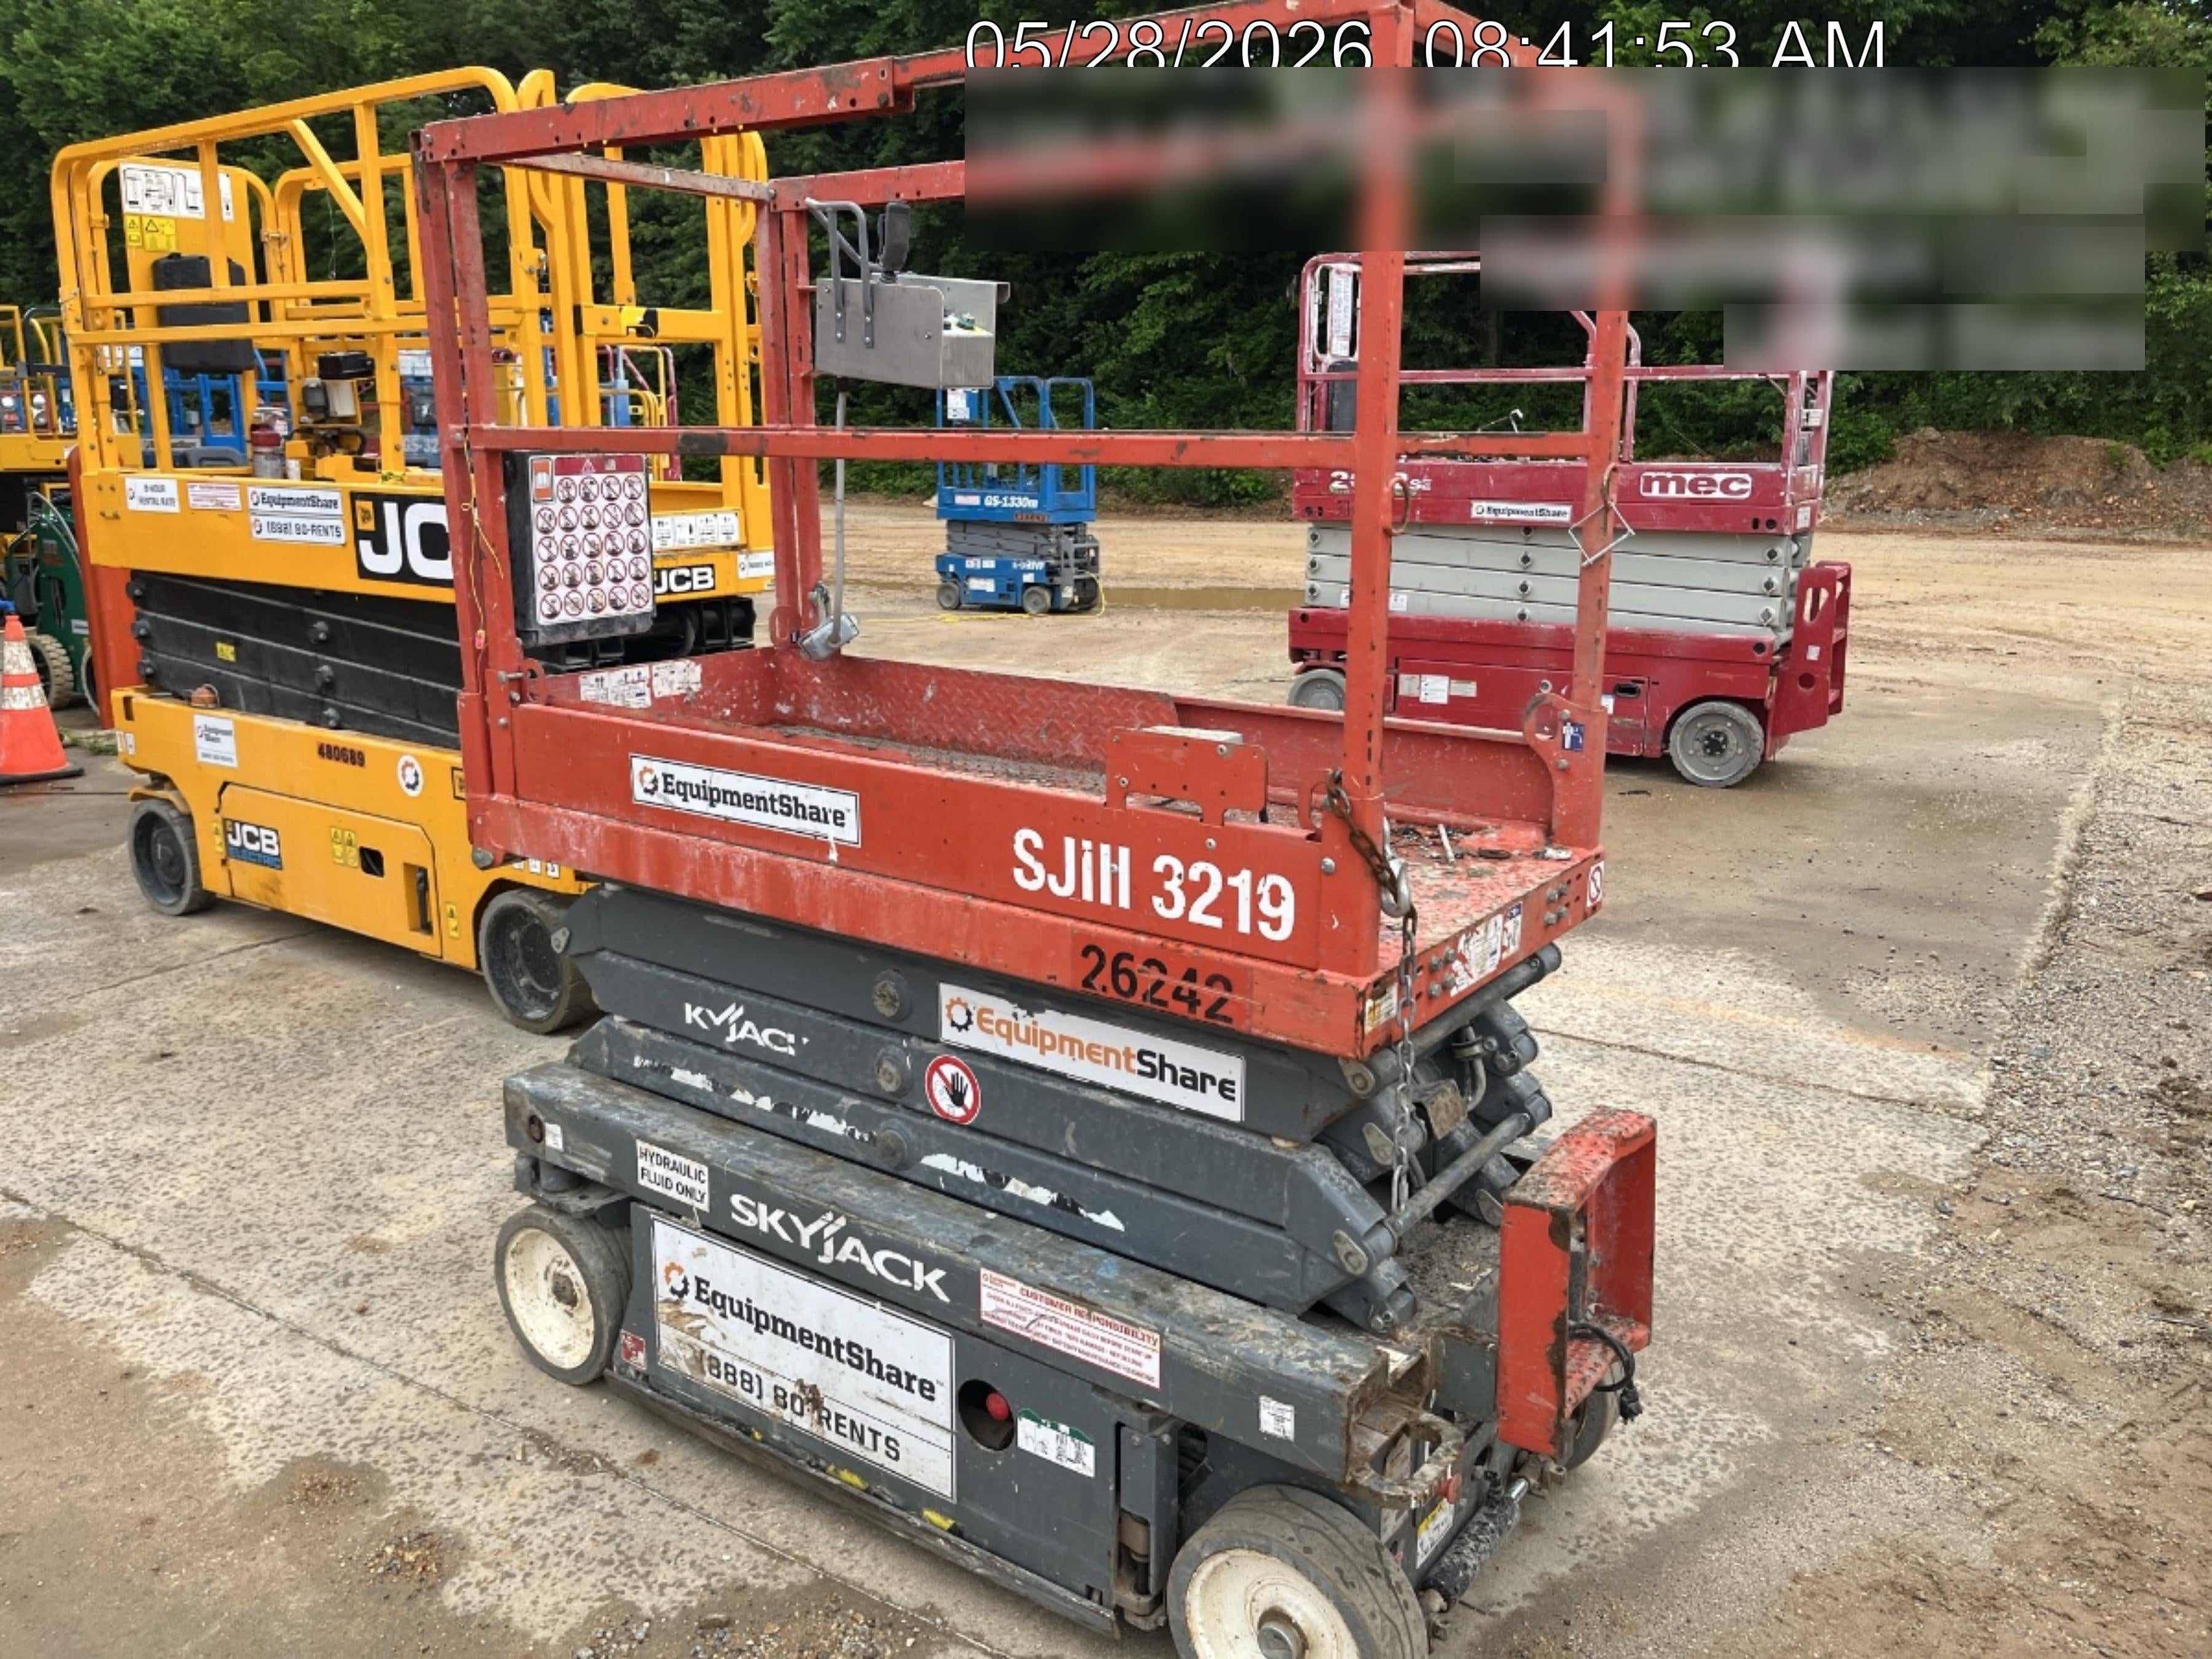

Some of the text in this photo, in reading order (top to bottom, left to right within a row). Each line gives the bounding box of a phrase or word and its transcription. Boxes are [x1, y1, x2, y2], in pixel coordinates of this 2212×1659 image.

[261, 492, 339, 509] EquipmentShare
[1486, 506, 1567, 517] EquipmentShare
[1642, 474, 1751, 496] mec
[654, 566, 715, 595] JCB
[662, 772, 846, 827] EquipmentShare
[227, 822, 280, 857] JCB
[1151, 854, 1295, 942] 3219
[1081, 943, 1234, 1025] 26242
[976, 1006, 1236, 1102] EquipmentShare
[639, 1145, 707, 1184] HYDRAULIC
[641, 1166, 707, 1204] FLUID ONLY
[729, 1193, 950, 1303] SKYJACK
[694, 1274, 936, 1402] EquipmentShare
[1020, 1286, 1072, 1314] CUSTOMER
[1074, 1306, 1158, 1346] REPONSIBILITY
[773, 1382, 901, 1462] 80RENTS
